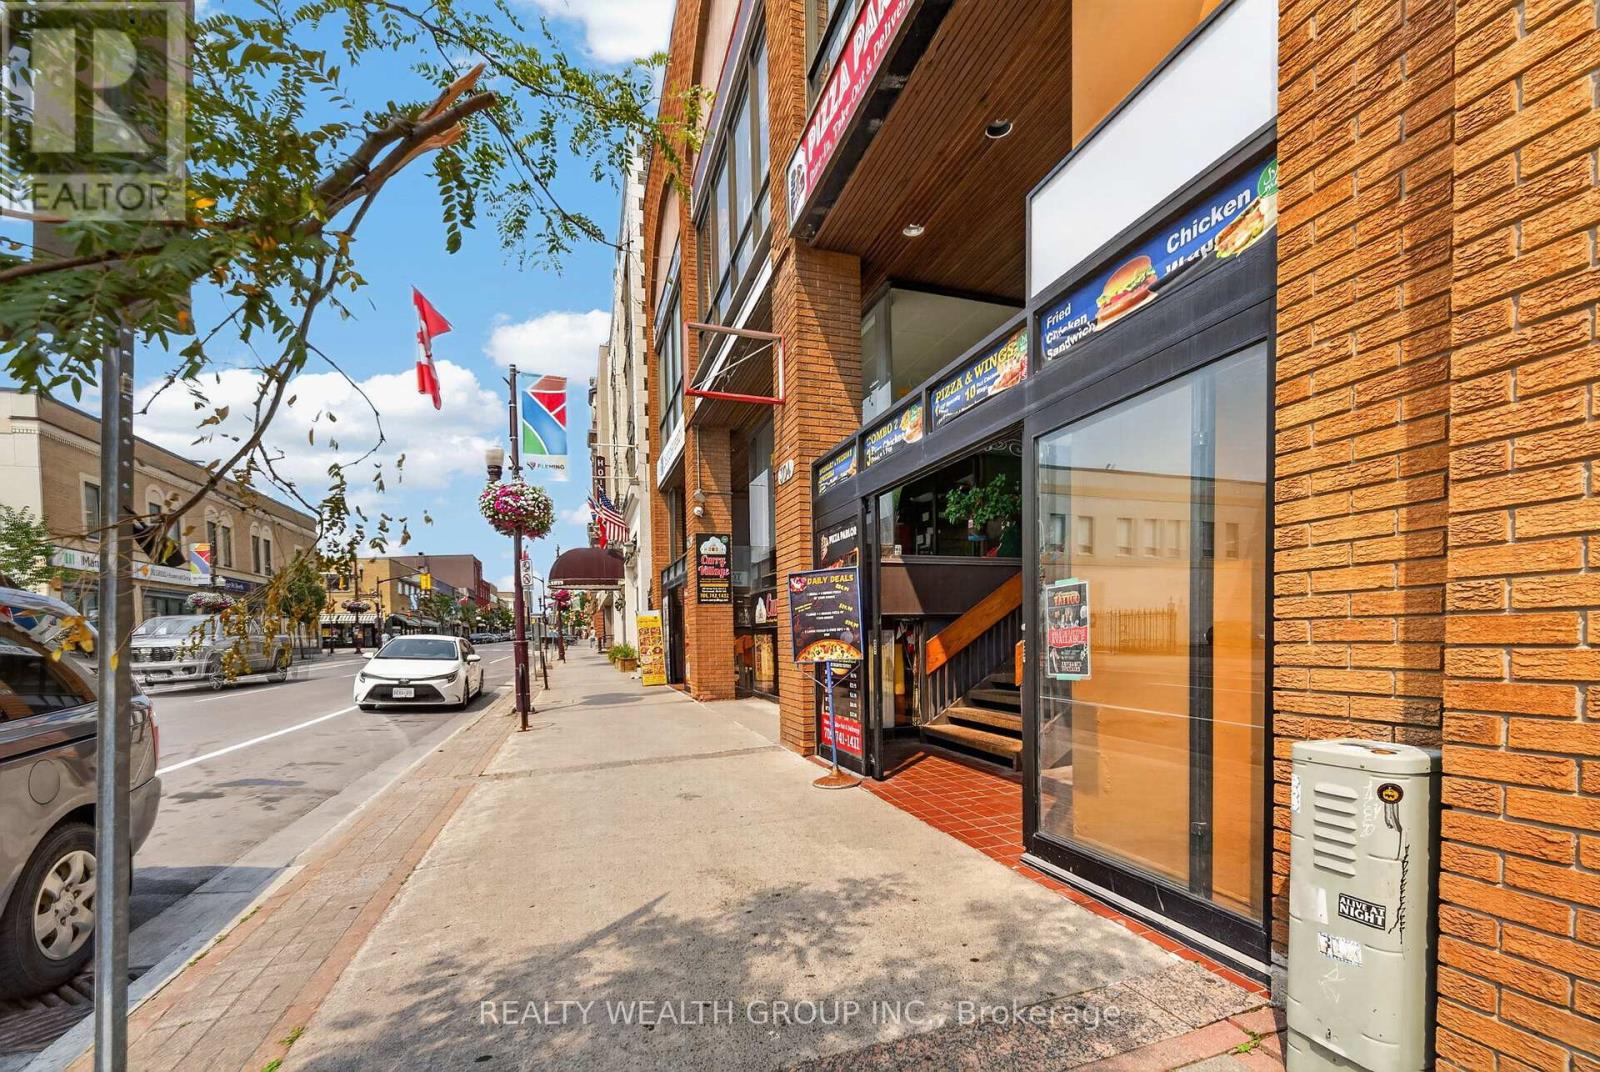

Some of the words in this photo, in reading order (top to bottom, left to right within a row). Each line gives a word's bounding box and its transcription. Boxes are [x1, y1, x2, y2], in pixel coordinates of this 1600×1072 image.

[806, 60, 851, 162] PIZZA
[1166, 188, 1252, 255] Chicken
[1046, 303, 1071, 329] Fried
[1046, 321, 1096, 361] Sandwich
[935, 376, 963, 404] PIZZA
[965, 370, 973, 385] &
[974, 343, 1017, 378] WINGS
[965, 383, 976, 401] 10
[867, 422, 893, 445] COMBO
[698, 566, 730, 578] Village
[700, 555, 727, 568] Curry
[807, 576, 828, 585] DAILY
[830, 574, 854, 583] DEALS
[1339, 903, 1385, 926] NIGHT
[1340, 897, 1368, 911] ALIVE
[1370, 906, 1385, 916] AT
